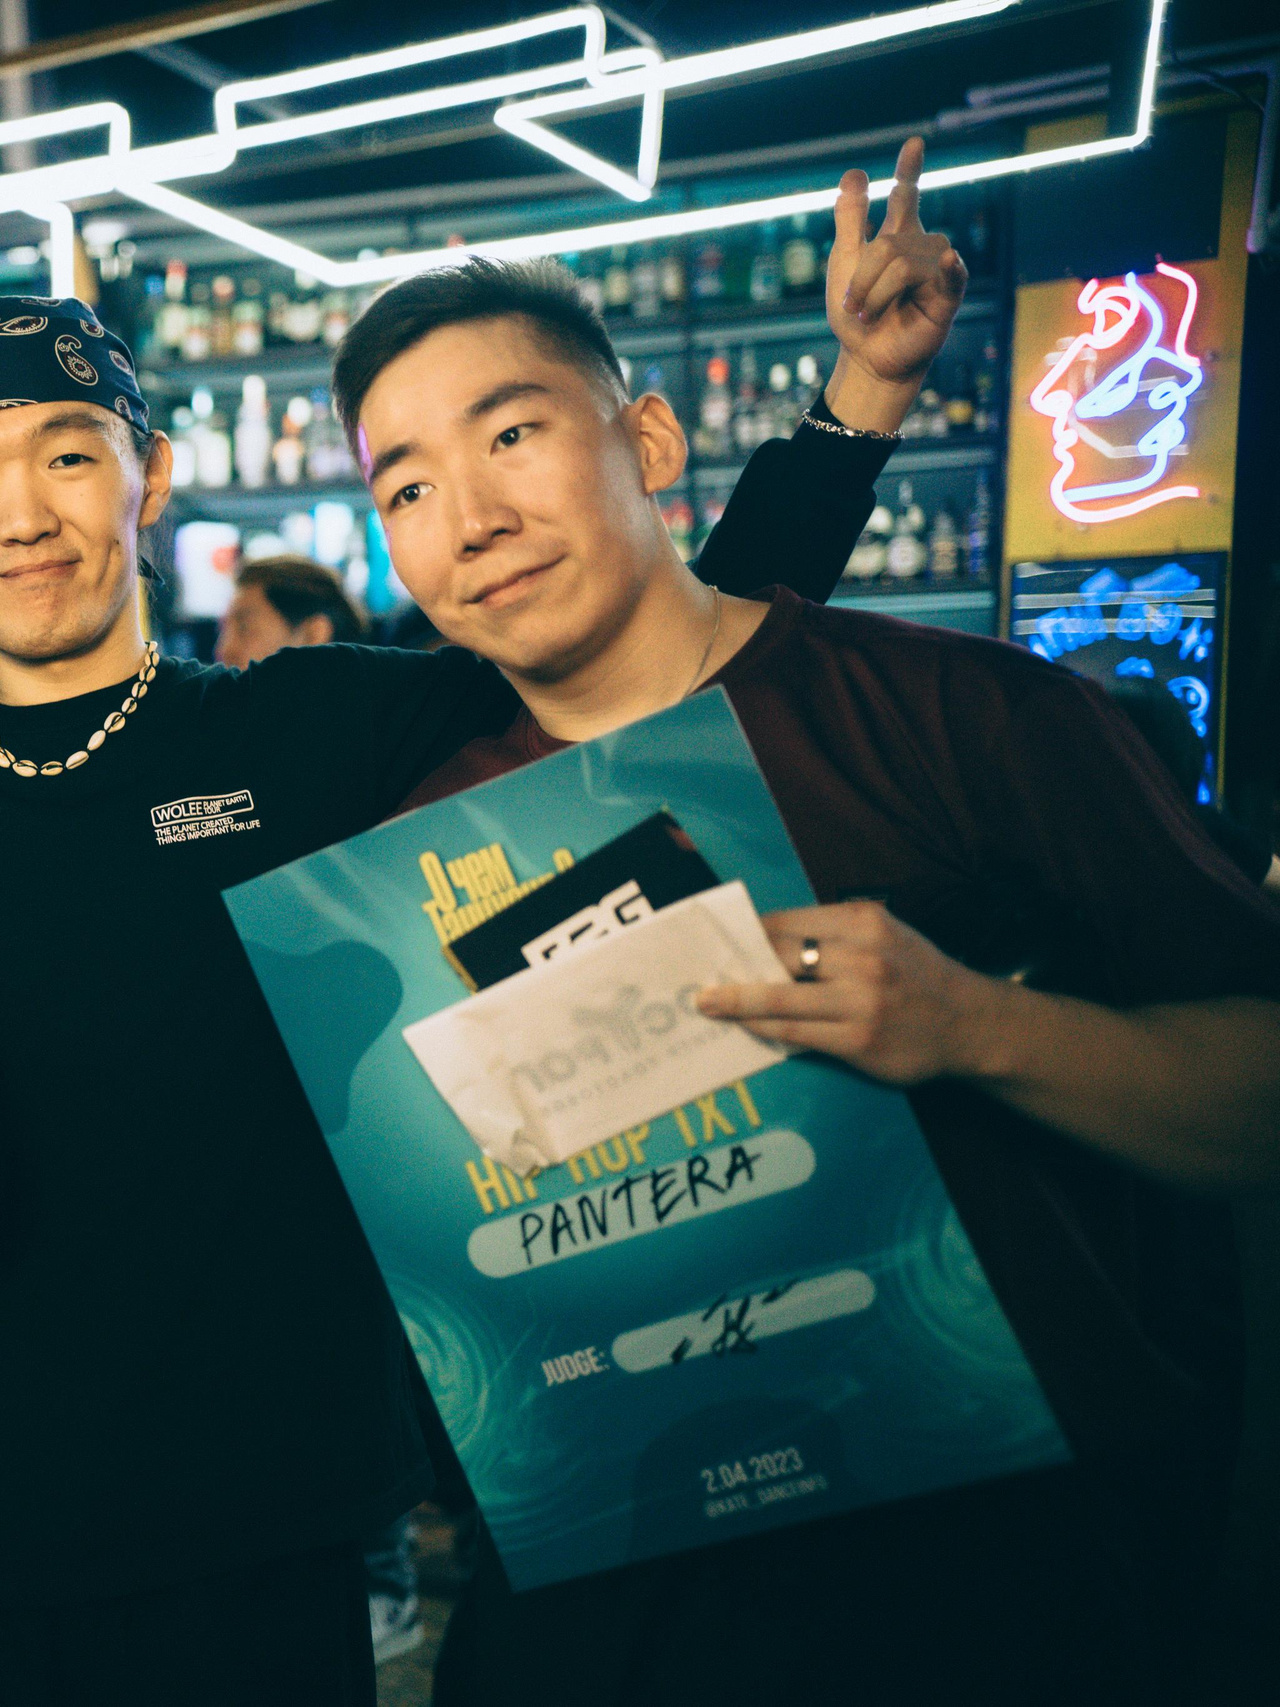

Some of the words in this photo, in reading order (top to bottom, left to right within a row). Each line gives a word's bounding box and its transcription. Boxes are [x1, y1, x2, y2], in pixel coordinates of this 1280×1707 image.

[156, 802, 203, 822] WOLEE
[203, 799, 226, 808] PLANET
[226, 794, 248, 805] EARTH
[204, 806, 221, 814] TOUR
[154, 827, 171, 837] THE
[172, 822, 200, 833] PLANET
[200, 816, 234, 829] CREATED
[156, 832, 187, 846] THINGS
[187, 825, 229, 840] IMPORTANT
[230, 823, 246, 832] FOR
[246, 819, 260, 829] LIFE
[520, 1144, 763, 1266] PANTERA
[541, 1346, 610, 1387] JUDGE:
[700, 1446, 805, 1494] 2.04.2023
